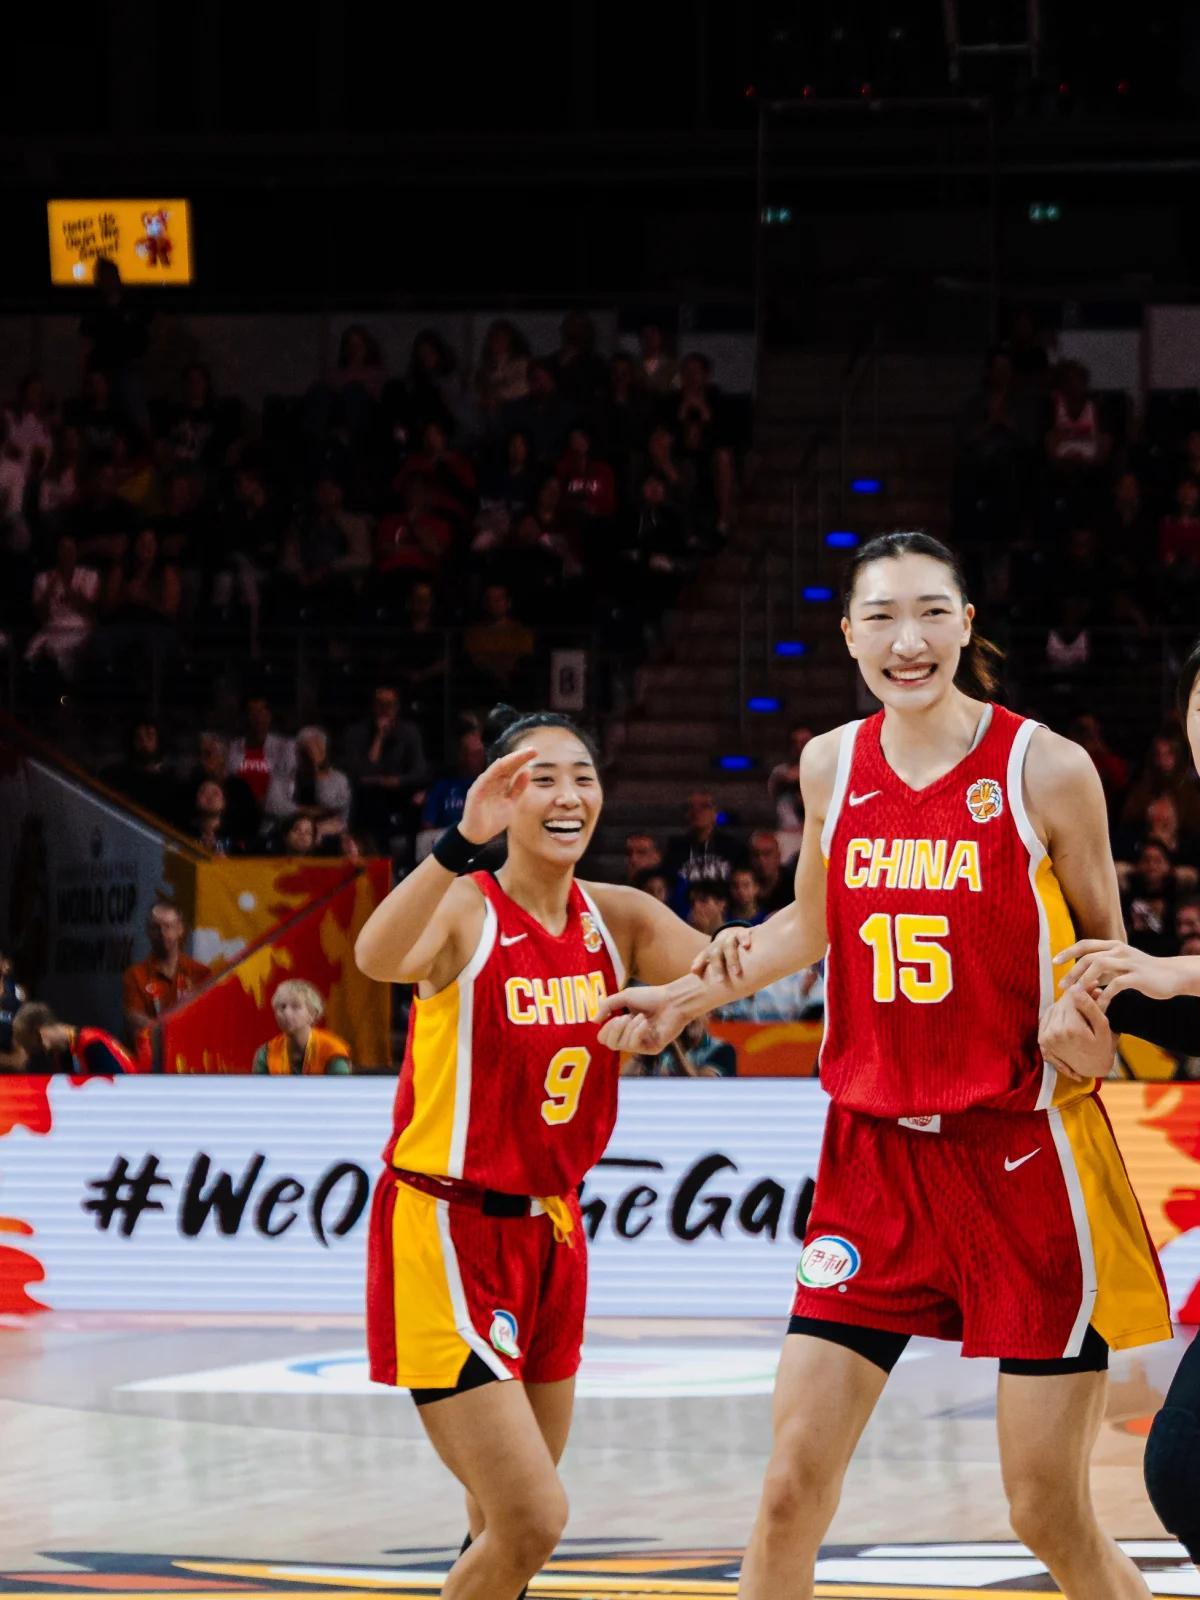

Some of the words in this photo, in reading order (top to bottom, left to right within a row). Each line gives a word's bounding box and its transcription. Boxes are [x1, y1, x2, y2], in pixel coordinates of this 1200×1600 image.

[844, 837, 983, 892] CHINA
[859, 912, 954, 1003] 15
[541, 1046, 592, 1126] 9
